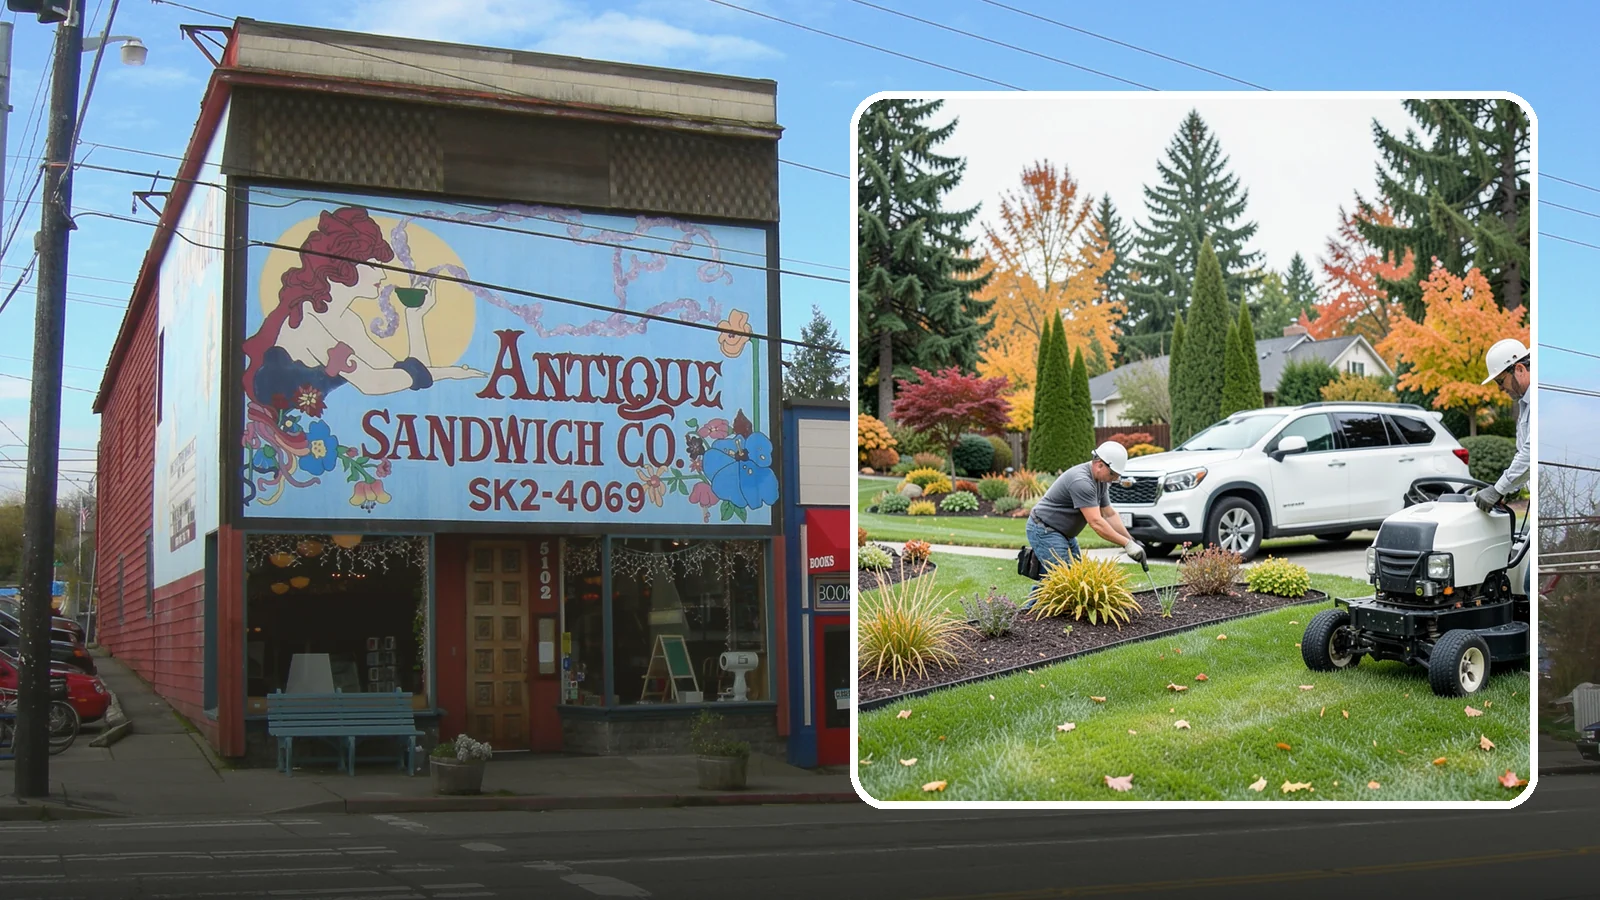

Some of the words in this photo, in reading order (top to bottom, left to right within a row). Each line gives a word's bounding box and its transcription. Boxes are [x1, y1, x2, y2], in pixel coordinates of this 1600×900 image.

[475, 329, 723, 420] ANTIQUE
[361, 409, 604, 467] SANDWICH
[617, 422, 684, 469] CO.
[469, 477, 645, 513] SK2-4069
[540, 541, 551, 600] 5102
[809, 555, 835, 569] BOOKS
